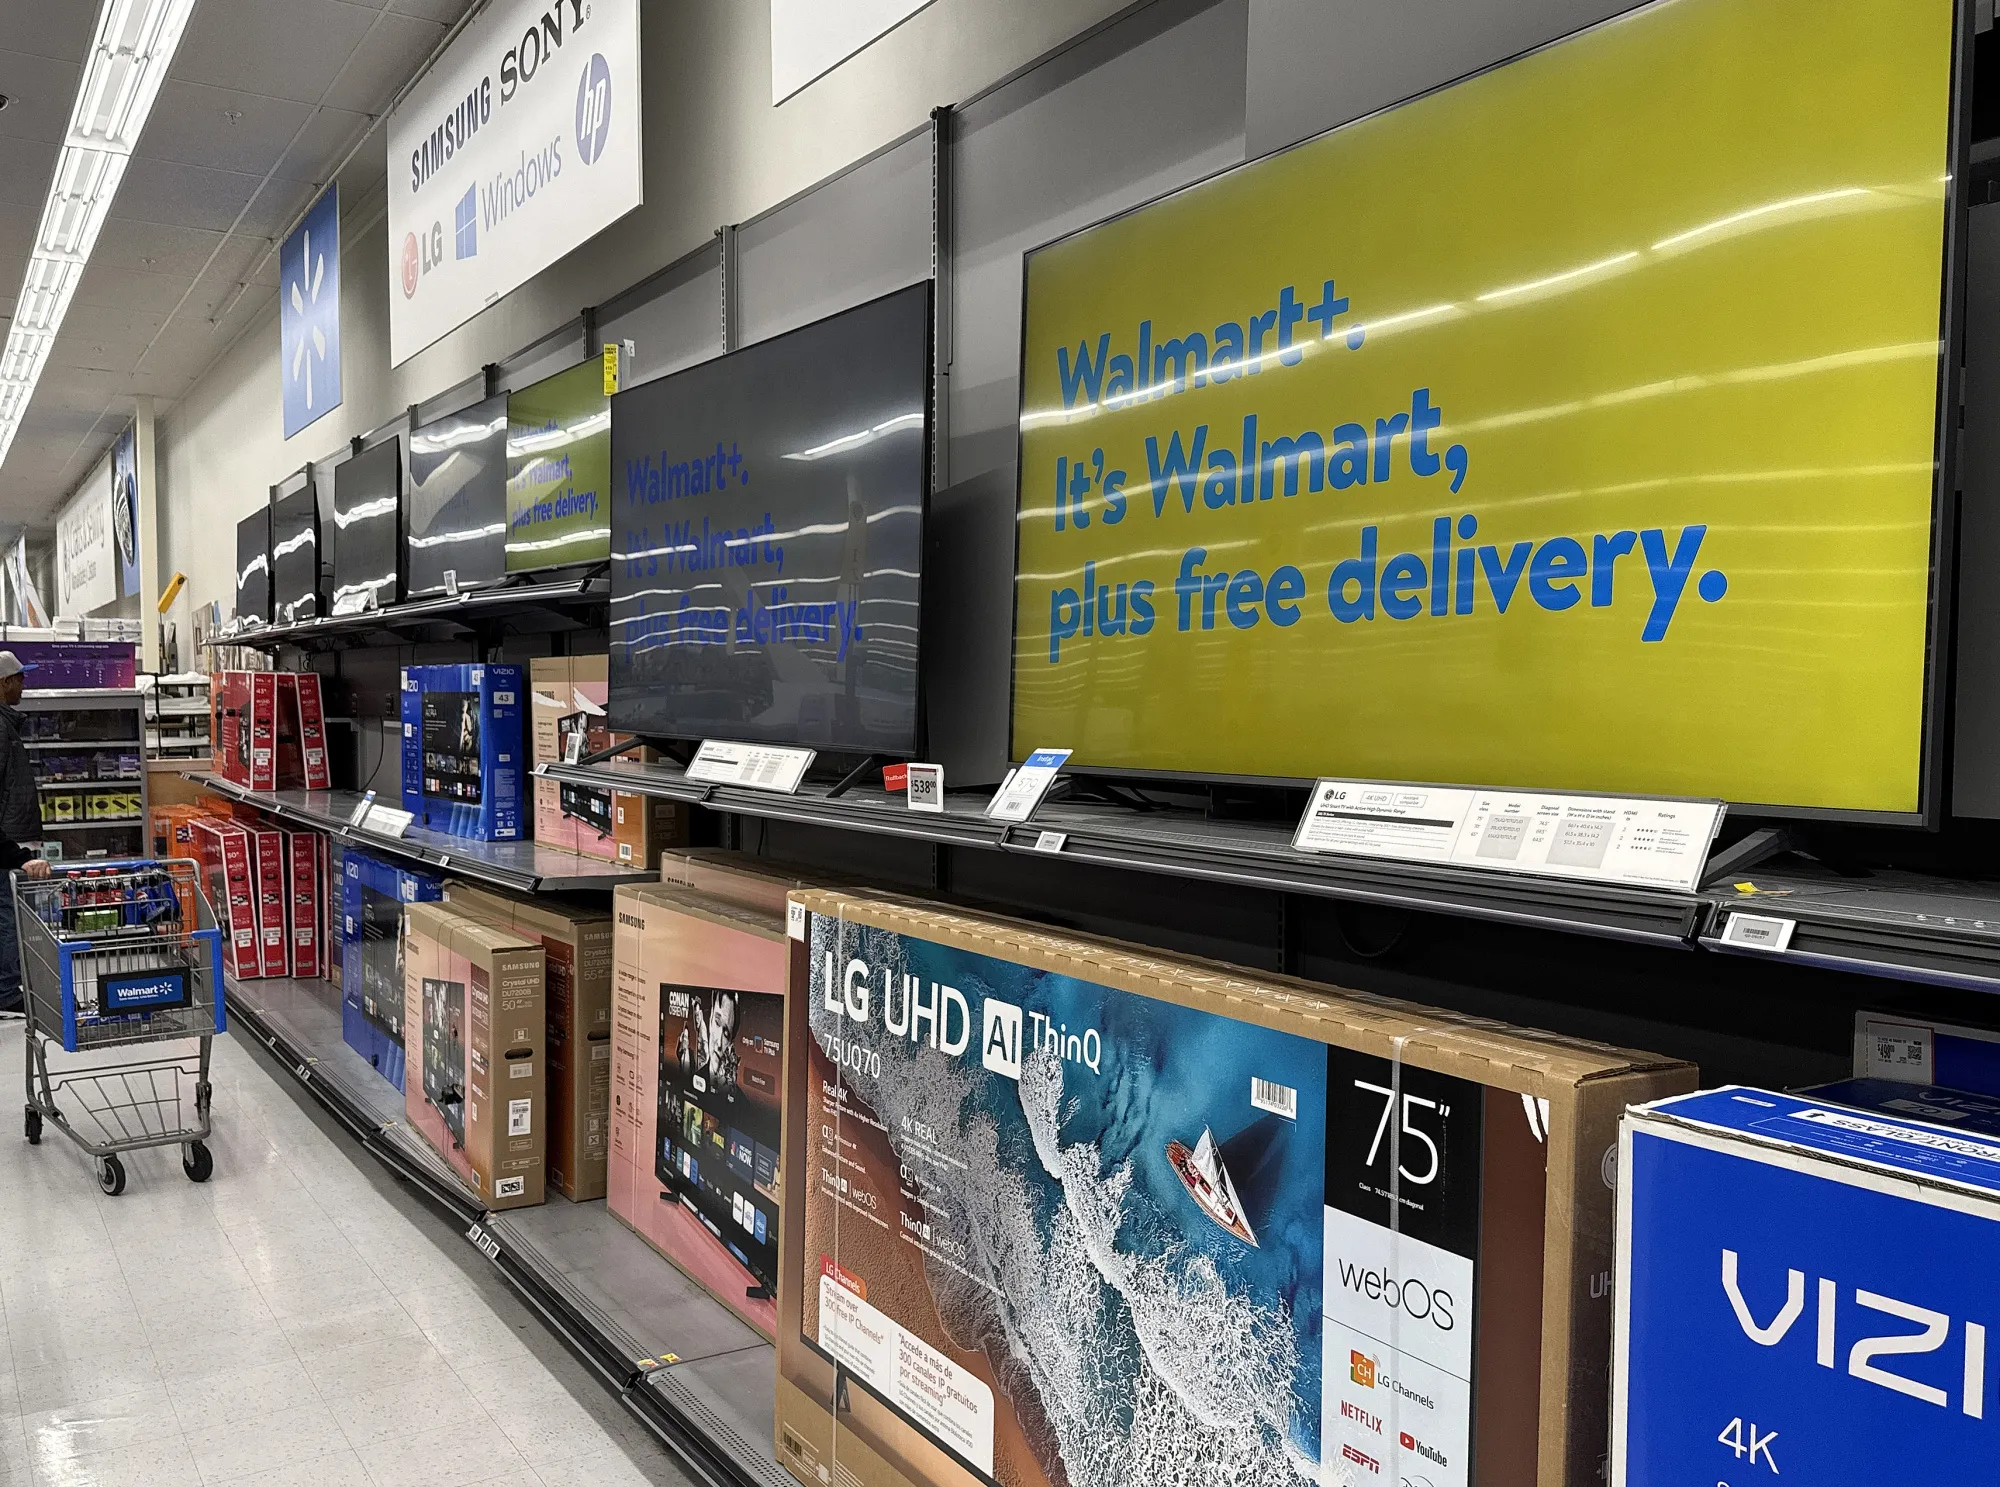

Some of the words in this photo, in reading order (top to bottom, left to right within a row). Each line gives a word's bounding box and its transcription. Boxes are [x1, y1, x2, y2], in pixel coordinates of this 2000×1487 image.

[501, 0, 584, 104] SONY
[578, 55, 610, 166] hp
[412, 76, 490, 193] SAMSUNG
[482, 136, 561, 232] Windows
[422, 221, 442, 275] LG
[1056, 279, 1366, 422] Walmart+.
[1144, 388, 1468, 495] Walmart,
[627, 442, 748, 507] Walmart+.
[533, 497, 553, 522] free
[555, 488, 599, 520] delivery.
[665, 512, 783, 573] Walmart,
[1049, 561, 1156, 662] plus
[1175, 547, 1305, 632] free
[1327, 513, 1728, 642] delivery.
[625, 600, 669, 663] plus
[677, 594, 729, 646] free
[735, 586, 863, 662] delivery.
[492, 668, 515, 676] VIZIO
[499, 694, 509, 702] 43
[1018, 778, 1038, 792] $79
[1334, 791, 1346, 800] LG
[618, 912, 646, 931] SAMSUNG
[502, 962, 540, 971] SAMSUNG
[584, 949, 607, 958] Crystal
[117, 985, 158, 997] Walmart
[502, 980, 526, 988] Crystal
[669, 991, 689, 1008] CONAN
[824, 950, 870, 1022] LG
[884, 968, 970, 1057] UHD
[986, 1014, 1018, 1065] AI
[1028, 1010, 1102, 1075] ThinQ
[764, 1038, 779, 1051] Samsung
[823, 1033, 882, 1079] 75UQ70
[822, 1081, 837, 1097] Real
[838, 1088, 848, 1103] 4K
[901, 1116, 913, 1133] 4K
[915, 1121, 938, 1145] REAL
[1354, 1079, 1451, 1185] 75"
[822, 1168, 840, 1191] ThinQ
[852, 1188, 876, 1209] webOS
[1358, 1182, 1371, 1192] Class
[1406, 1200, 1424, 1210] diagonal
[900, 1210, 922, 1238] ThinQ
[936, 1233, 966, 1260] webOS
[826, 1261, 833, 1276] LG
[835, 1268, 861, 1294] Channels
[846, 1300, 858, 1313] over
[1338, 1258, 1454, 1331] webOS
[837, 1304, 848, 1322] free
[849, 1313, 854, 1323] IP
[899, 1349, 912, 1366] 300
[913, 1361, 936, 1385] canales
[938, 1377, 945, 1388] IP
[946, 1384, 978, 1414] gratuitos
[900, 1366, 911, 1380] por
[924, 1353, 928, 1362] a
[929, 1357, 942, 1373] más
[944, 1366, 953, 1380] de
[1357, 1363, 1372, 1380] CH
[1377, 1373, 1390, 1388] LG
[1392, 1380, 1434, 1410] Channels
[1341, 1400, 1383, 1435] NETFLIX
[1342, 1443, 1380, 1474] ESPN
[1416, 1440, 1447, 1467] YouTube
[1717, 1416, 1780, 1475] 4K
